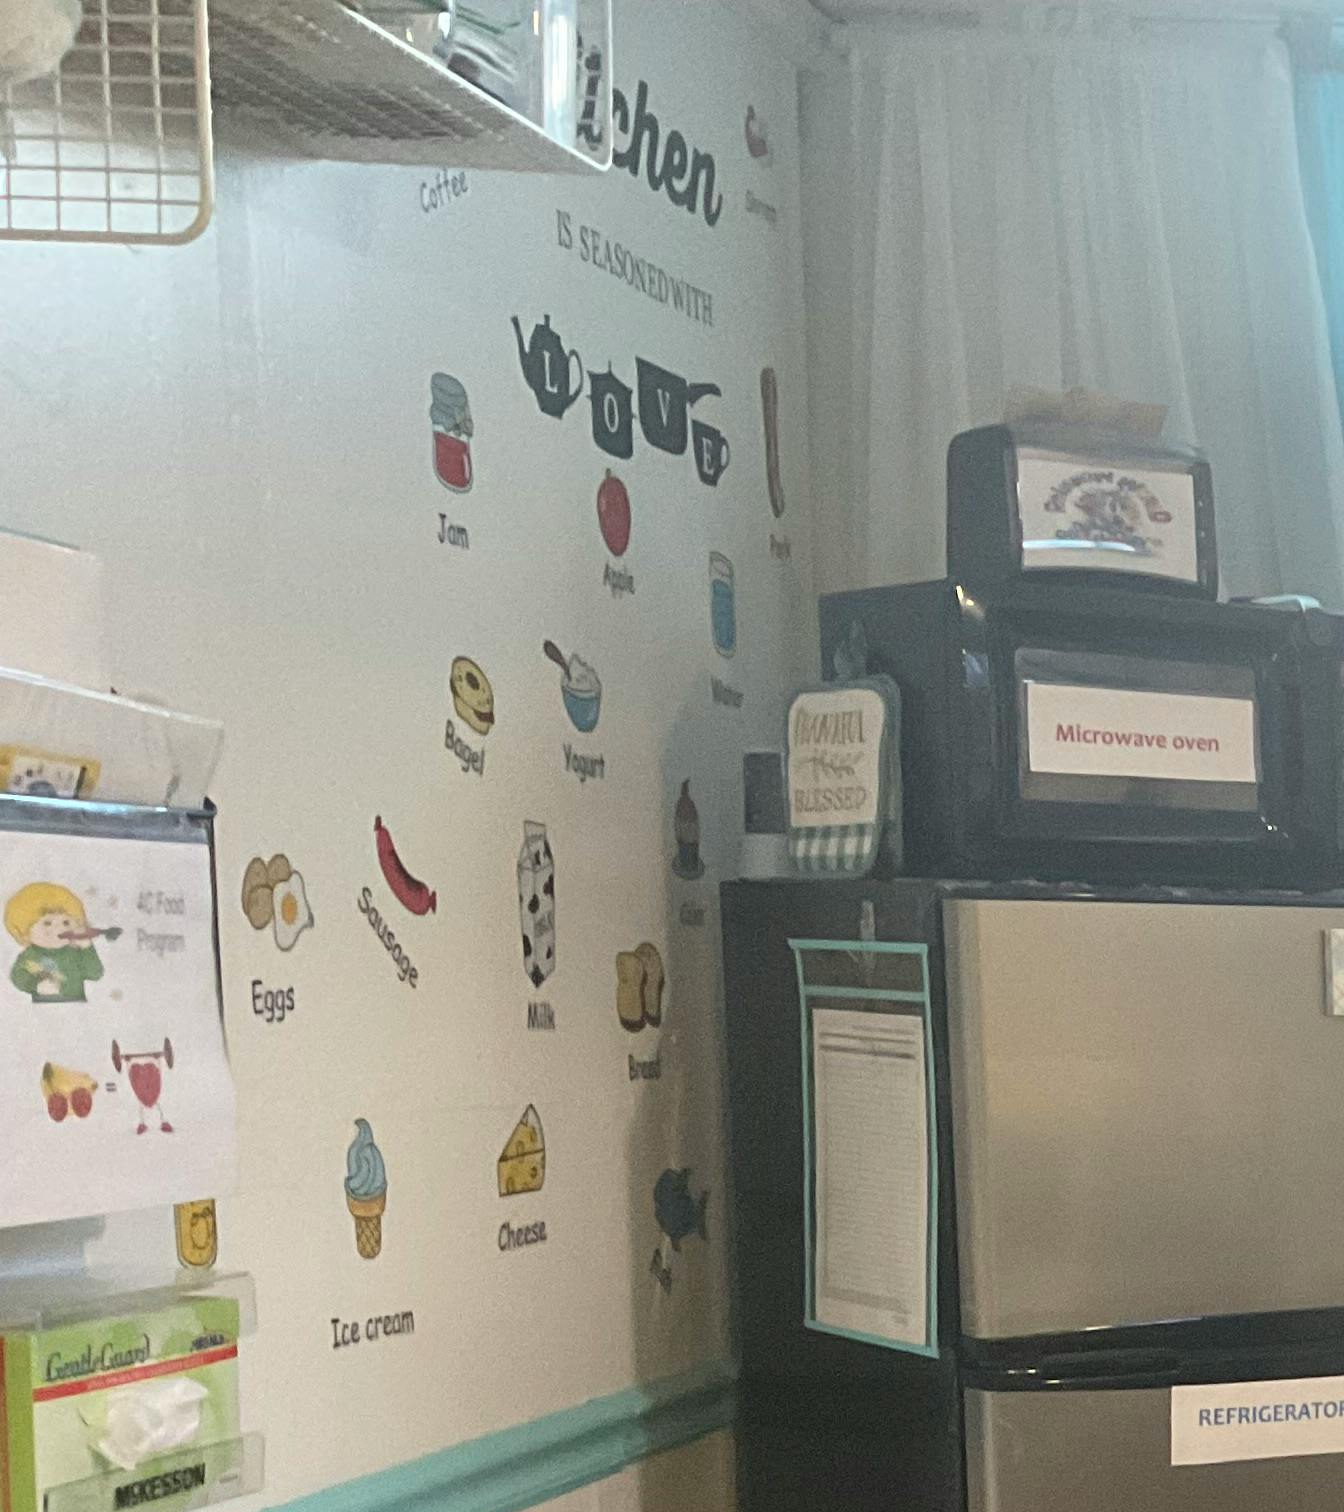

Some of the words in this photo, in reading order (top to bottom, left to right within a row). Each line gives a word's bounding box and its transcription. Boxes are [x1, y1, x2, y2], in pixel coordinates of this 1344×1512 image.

[419, 168, 469, 213] Coffee
[555, 208, 573, 250] IS
[579, 224, 669, 304] SEASONED
[669, 277, 714, 326] WITH
[437, 513, 470, 549] Jam
[602, 563, 636, 599] Apple
[445, 720, 486, 777] Bagel
[563, 743, 605, 783] Yogurt
[1056, 722, 1168, 749] Microwave
[1172, 735, 1220, 752] oven
[358, 887, 419, 989] Sausage
[251, 980, 295, 1023] Eggs
[527, 1002, 555, 1030] Milk
[498, 1220, 548, 1251] Cheese
[331, 1317, 360, 1349] Ice
[366, 1310, 415, 1342] cream
